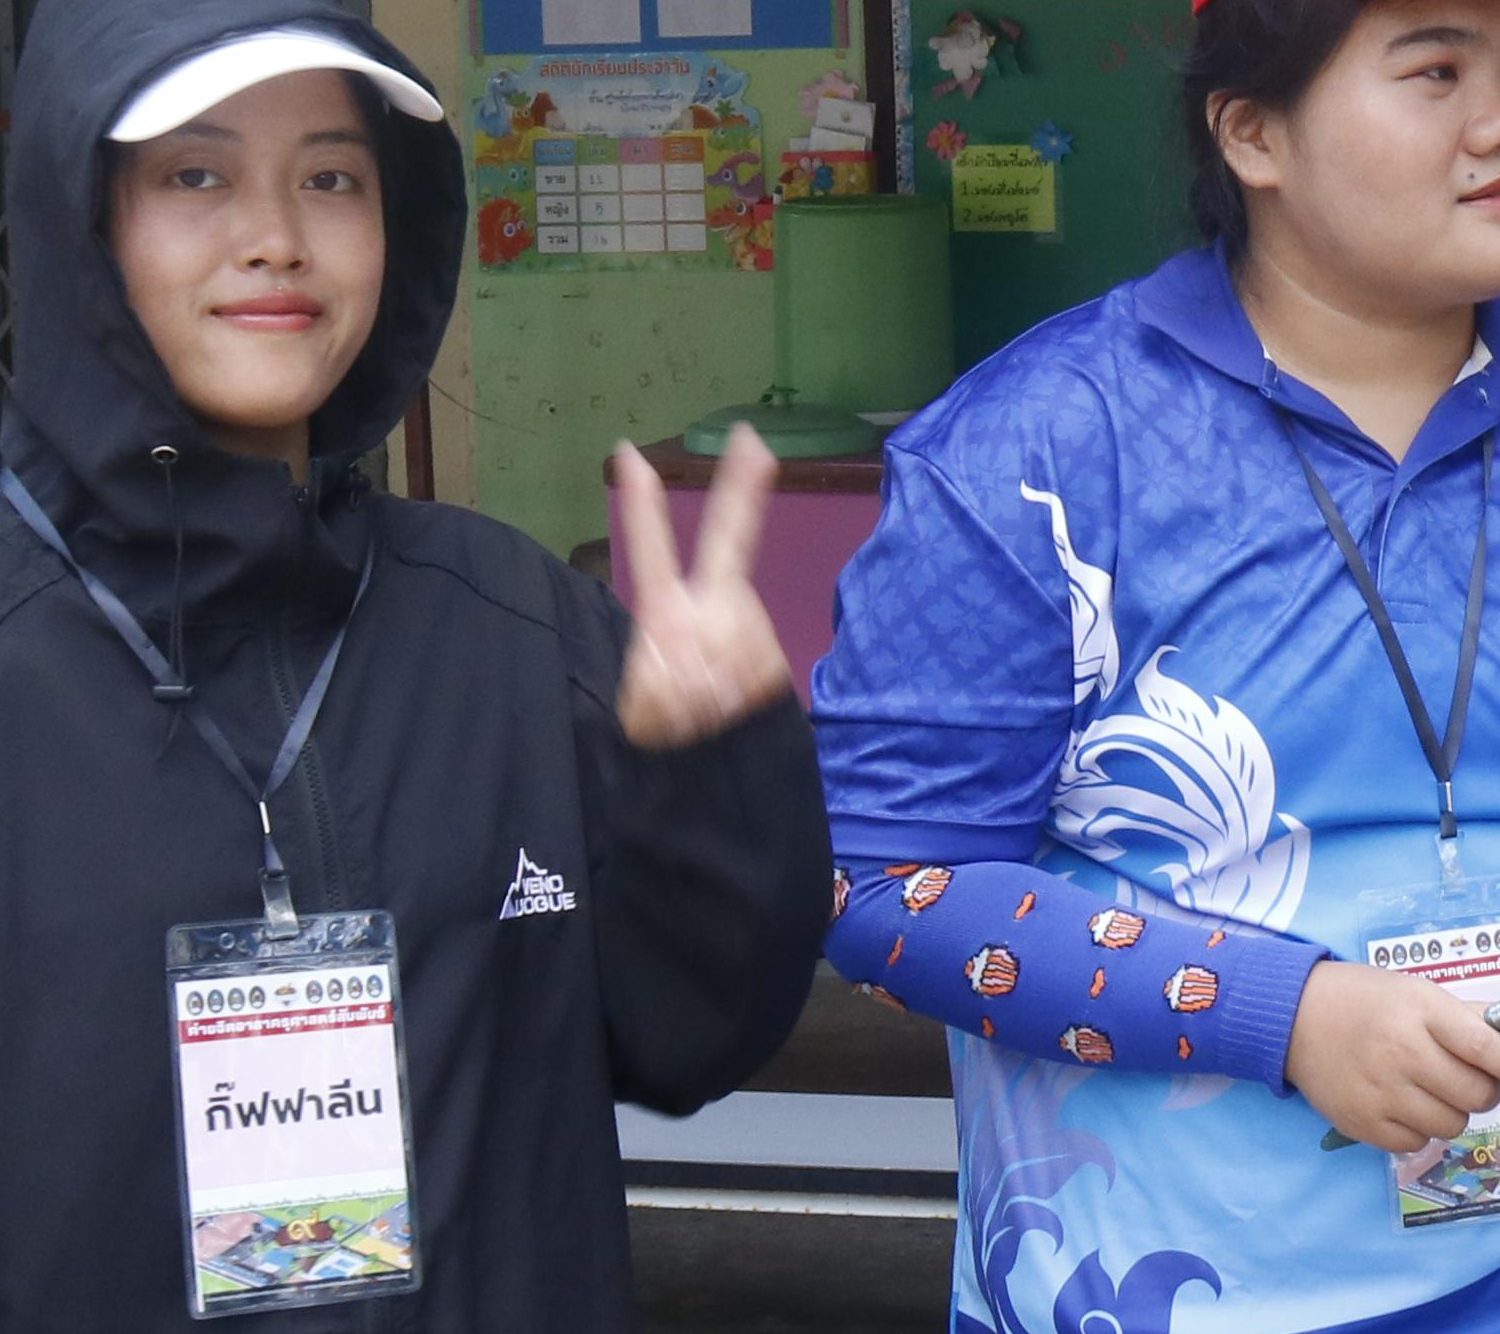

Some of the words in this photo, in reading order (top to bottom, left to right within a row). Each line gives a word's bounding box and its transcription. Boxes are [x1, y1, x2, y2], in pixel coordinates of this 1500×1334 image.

[545, 202, 569, 218] หญิง
[548, 235, 569, 245] รวม
[187, 1005, 386, 1037] ค่ายจิตอาสาครุศาสตร์สัมพันธ์
[205, 1078, 383, 1132] กิ๊ฟฟาลีน
